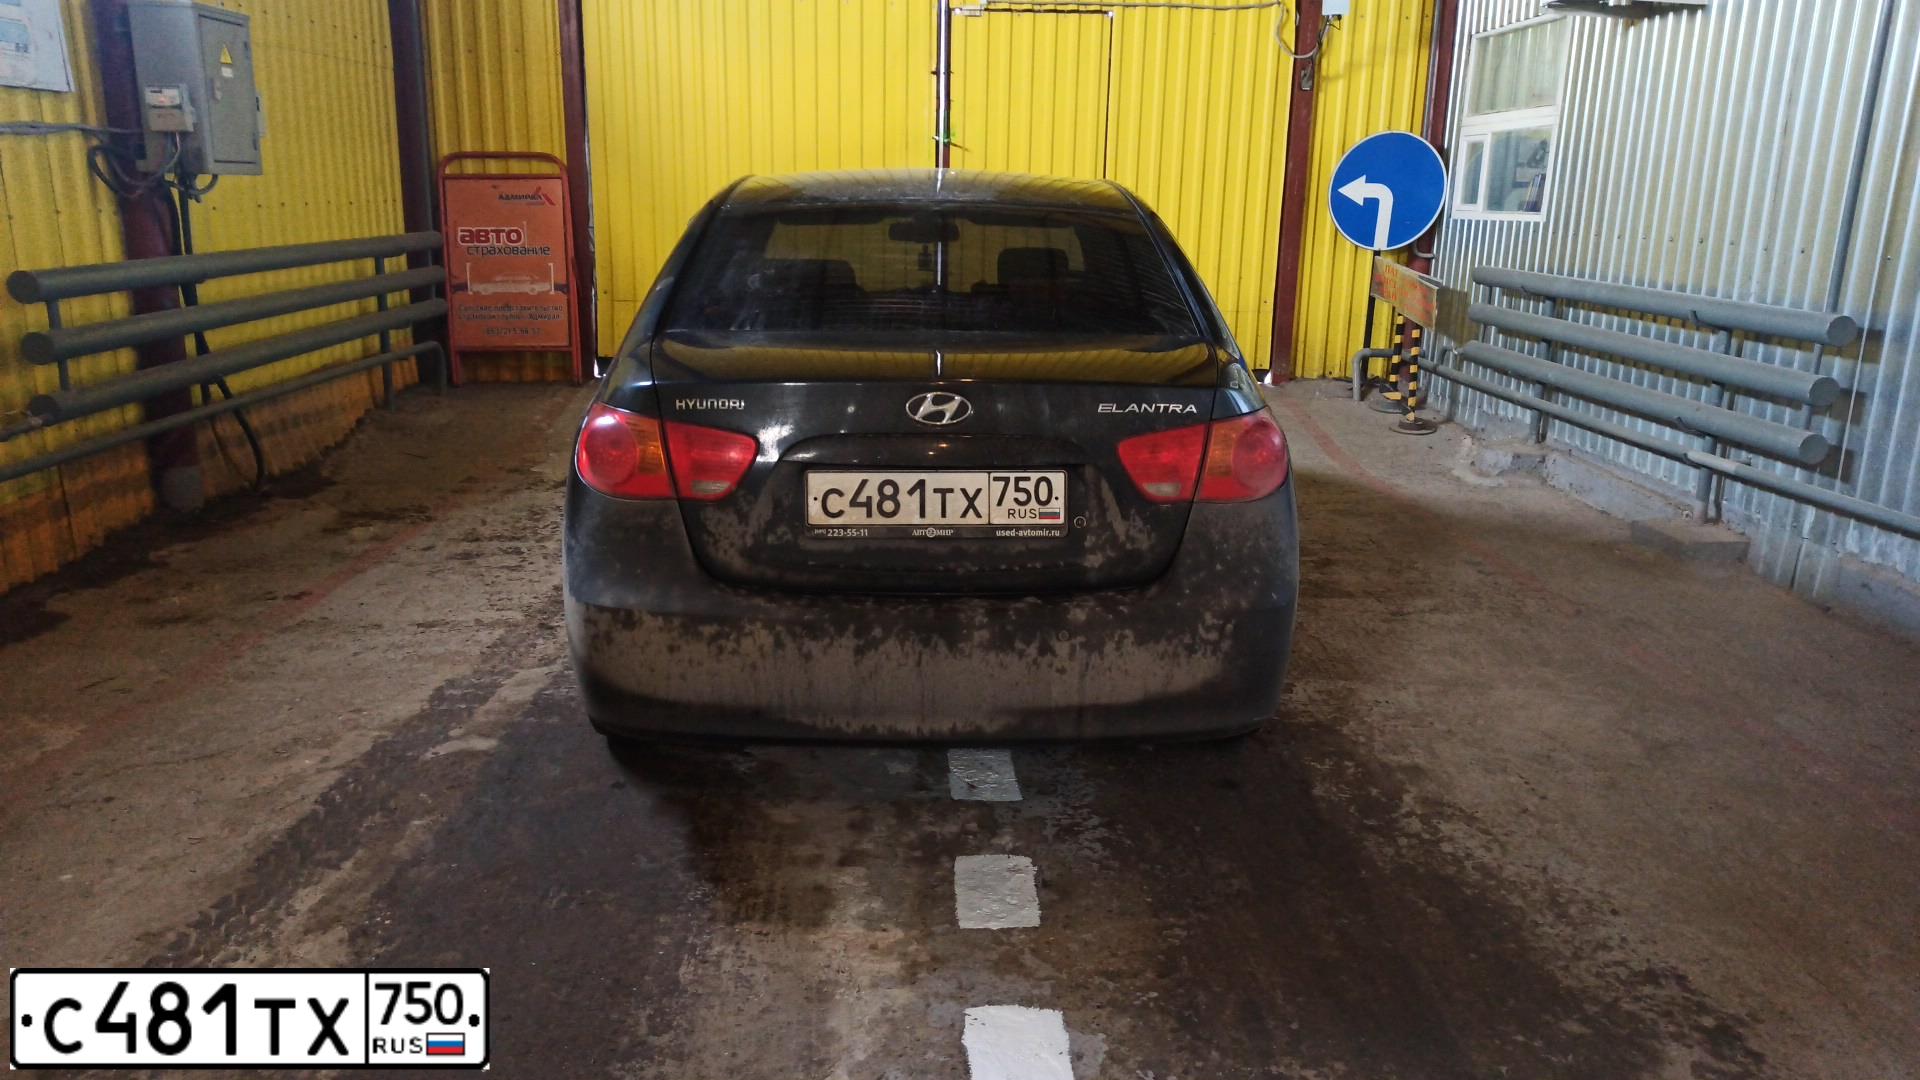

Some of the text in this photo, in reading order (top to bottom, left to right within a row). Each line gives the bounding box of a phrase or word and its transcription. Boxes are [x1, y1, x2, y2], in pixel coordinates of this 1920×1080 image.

[459, 228, 523, 245] авто
[467, 246, 551, 257] страхование
[675, 398, 745, 410] HYUNDAI
[1097, 403, 1198, 414] ELANTRA
[992, 475, 1054, 507] 750
[1007, 508, 1038, 519] RUS
[995, 527, 1061, 538] used-avtomir.ru
